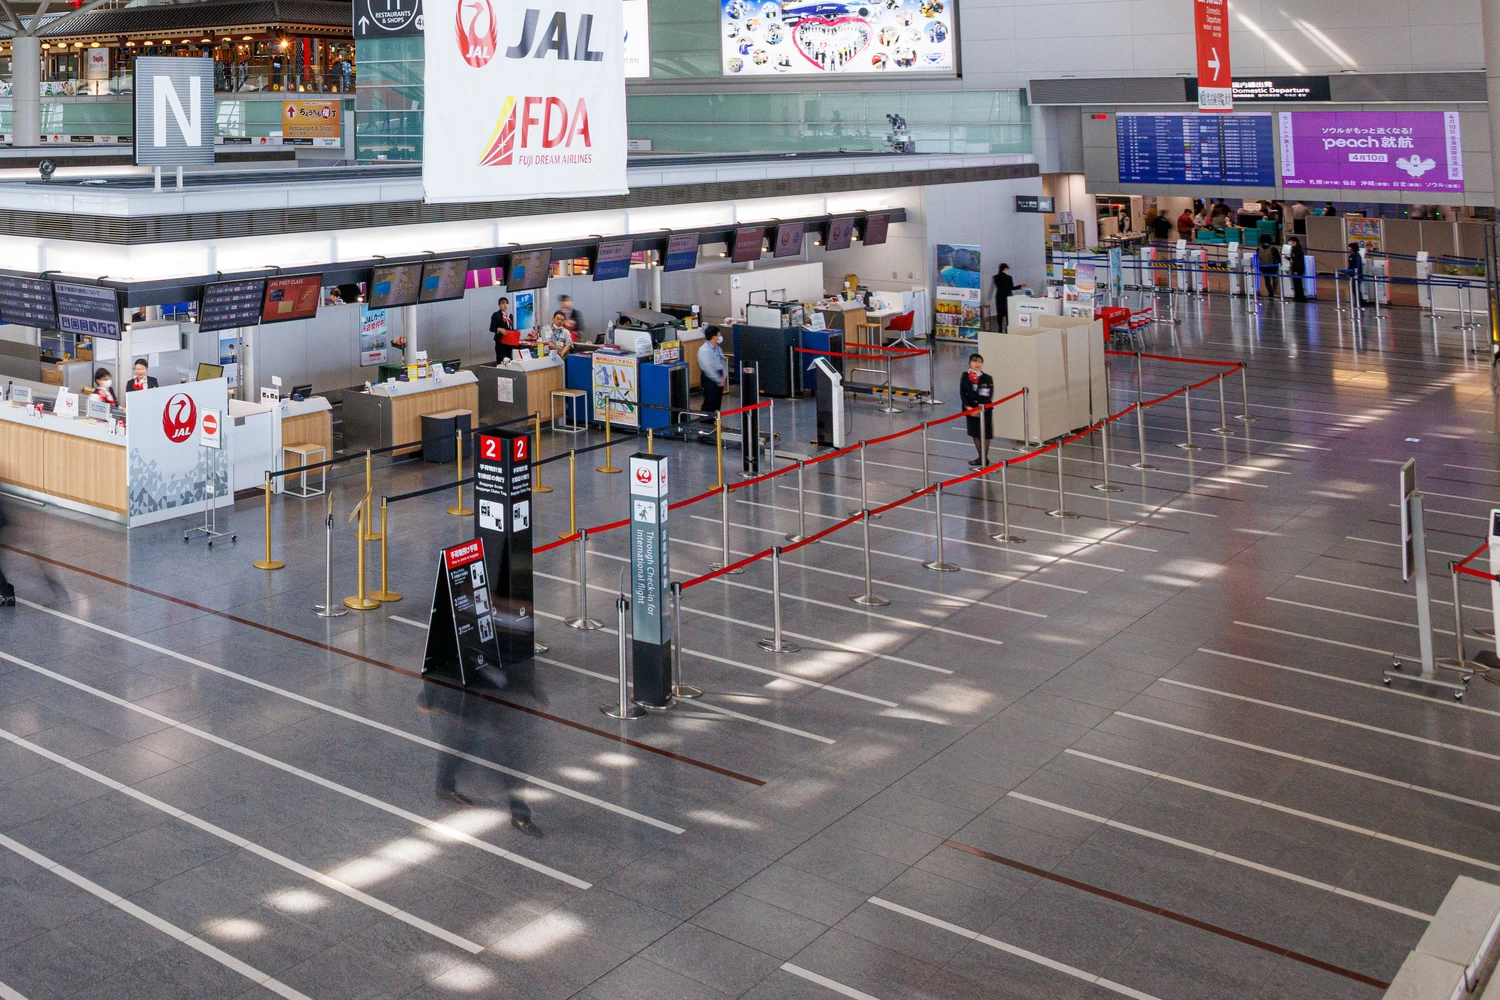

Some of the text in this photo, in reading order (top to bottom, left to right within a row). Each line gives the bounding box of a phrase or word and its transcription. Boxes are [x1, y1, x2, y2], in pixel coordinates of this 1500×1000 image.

[375, 10, 411, 19] RESTAURANTS
[387, 16, 405, 24] SHOPS
[505, 8, 604, 62] JAL
[465, 45, 491, 60] JAL
[1269, 87, 1310, 95] Departure
[153, 75, 201, 147] N
[520, 95, 592, 149] FDA
[1321, 135, 1414, 151] peach 就航
[518, 153, 593, 168] FUJI DREAM AIRLINES
[363, 311, 384, 324] JALカード
[13, 388, 28, 397] CLOSED
[91, 403, 107, 414] CLOSED
[172, 428, 191, 439] JAL
[486, 439, 496, 458] 2
[517, 440, 524, 458] 2
[646, 530, 654, 566] Through
[636, 529, 645, 605] International flight
[646, 566, 655, 601] Check-in
